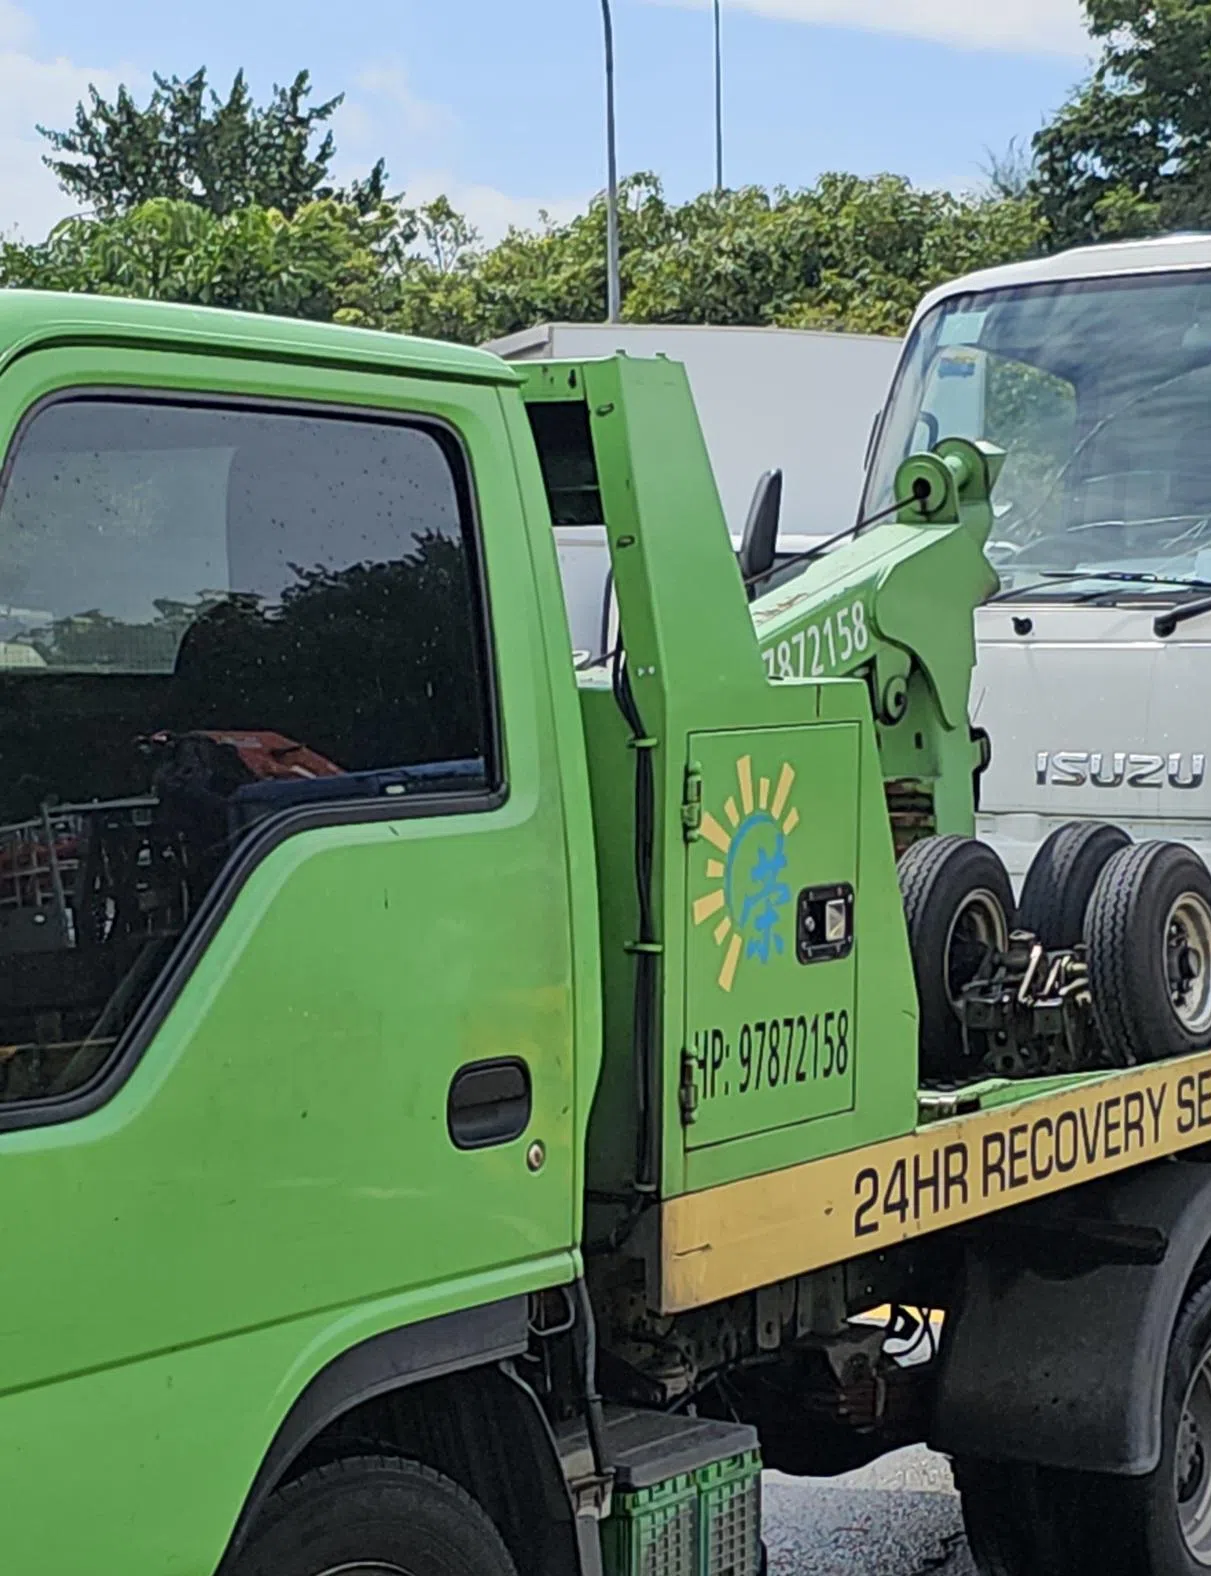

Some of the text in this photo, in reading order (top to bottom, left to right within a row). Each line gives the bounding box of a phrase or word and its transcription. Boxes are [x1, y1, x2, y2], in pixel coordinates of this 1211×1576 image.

[1036, 751, 1205, 790] ISUZU
[695, 1009, 849, 1100] HP: 97872158
[853, 1141, 968, 1239] 24HR
[982, 1083, 1168, 1199] RECOVERY
